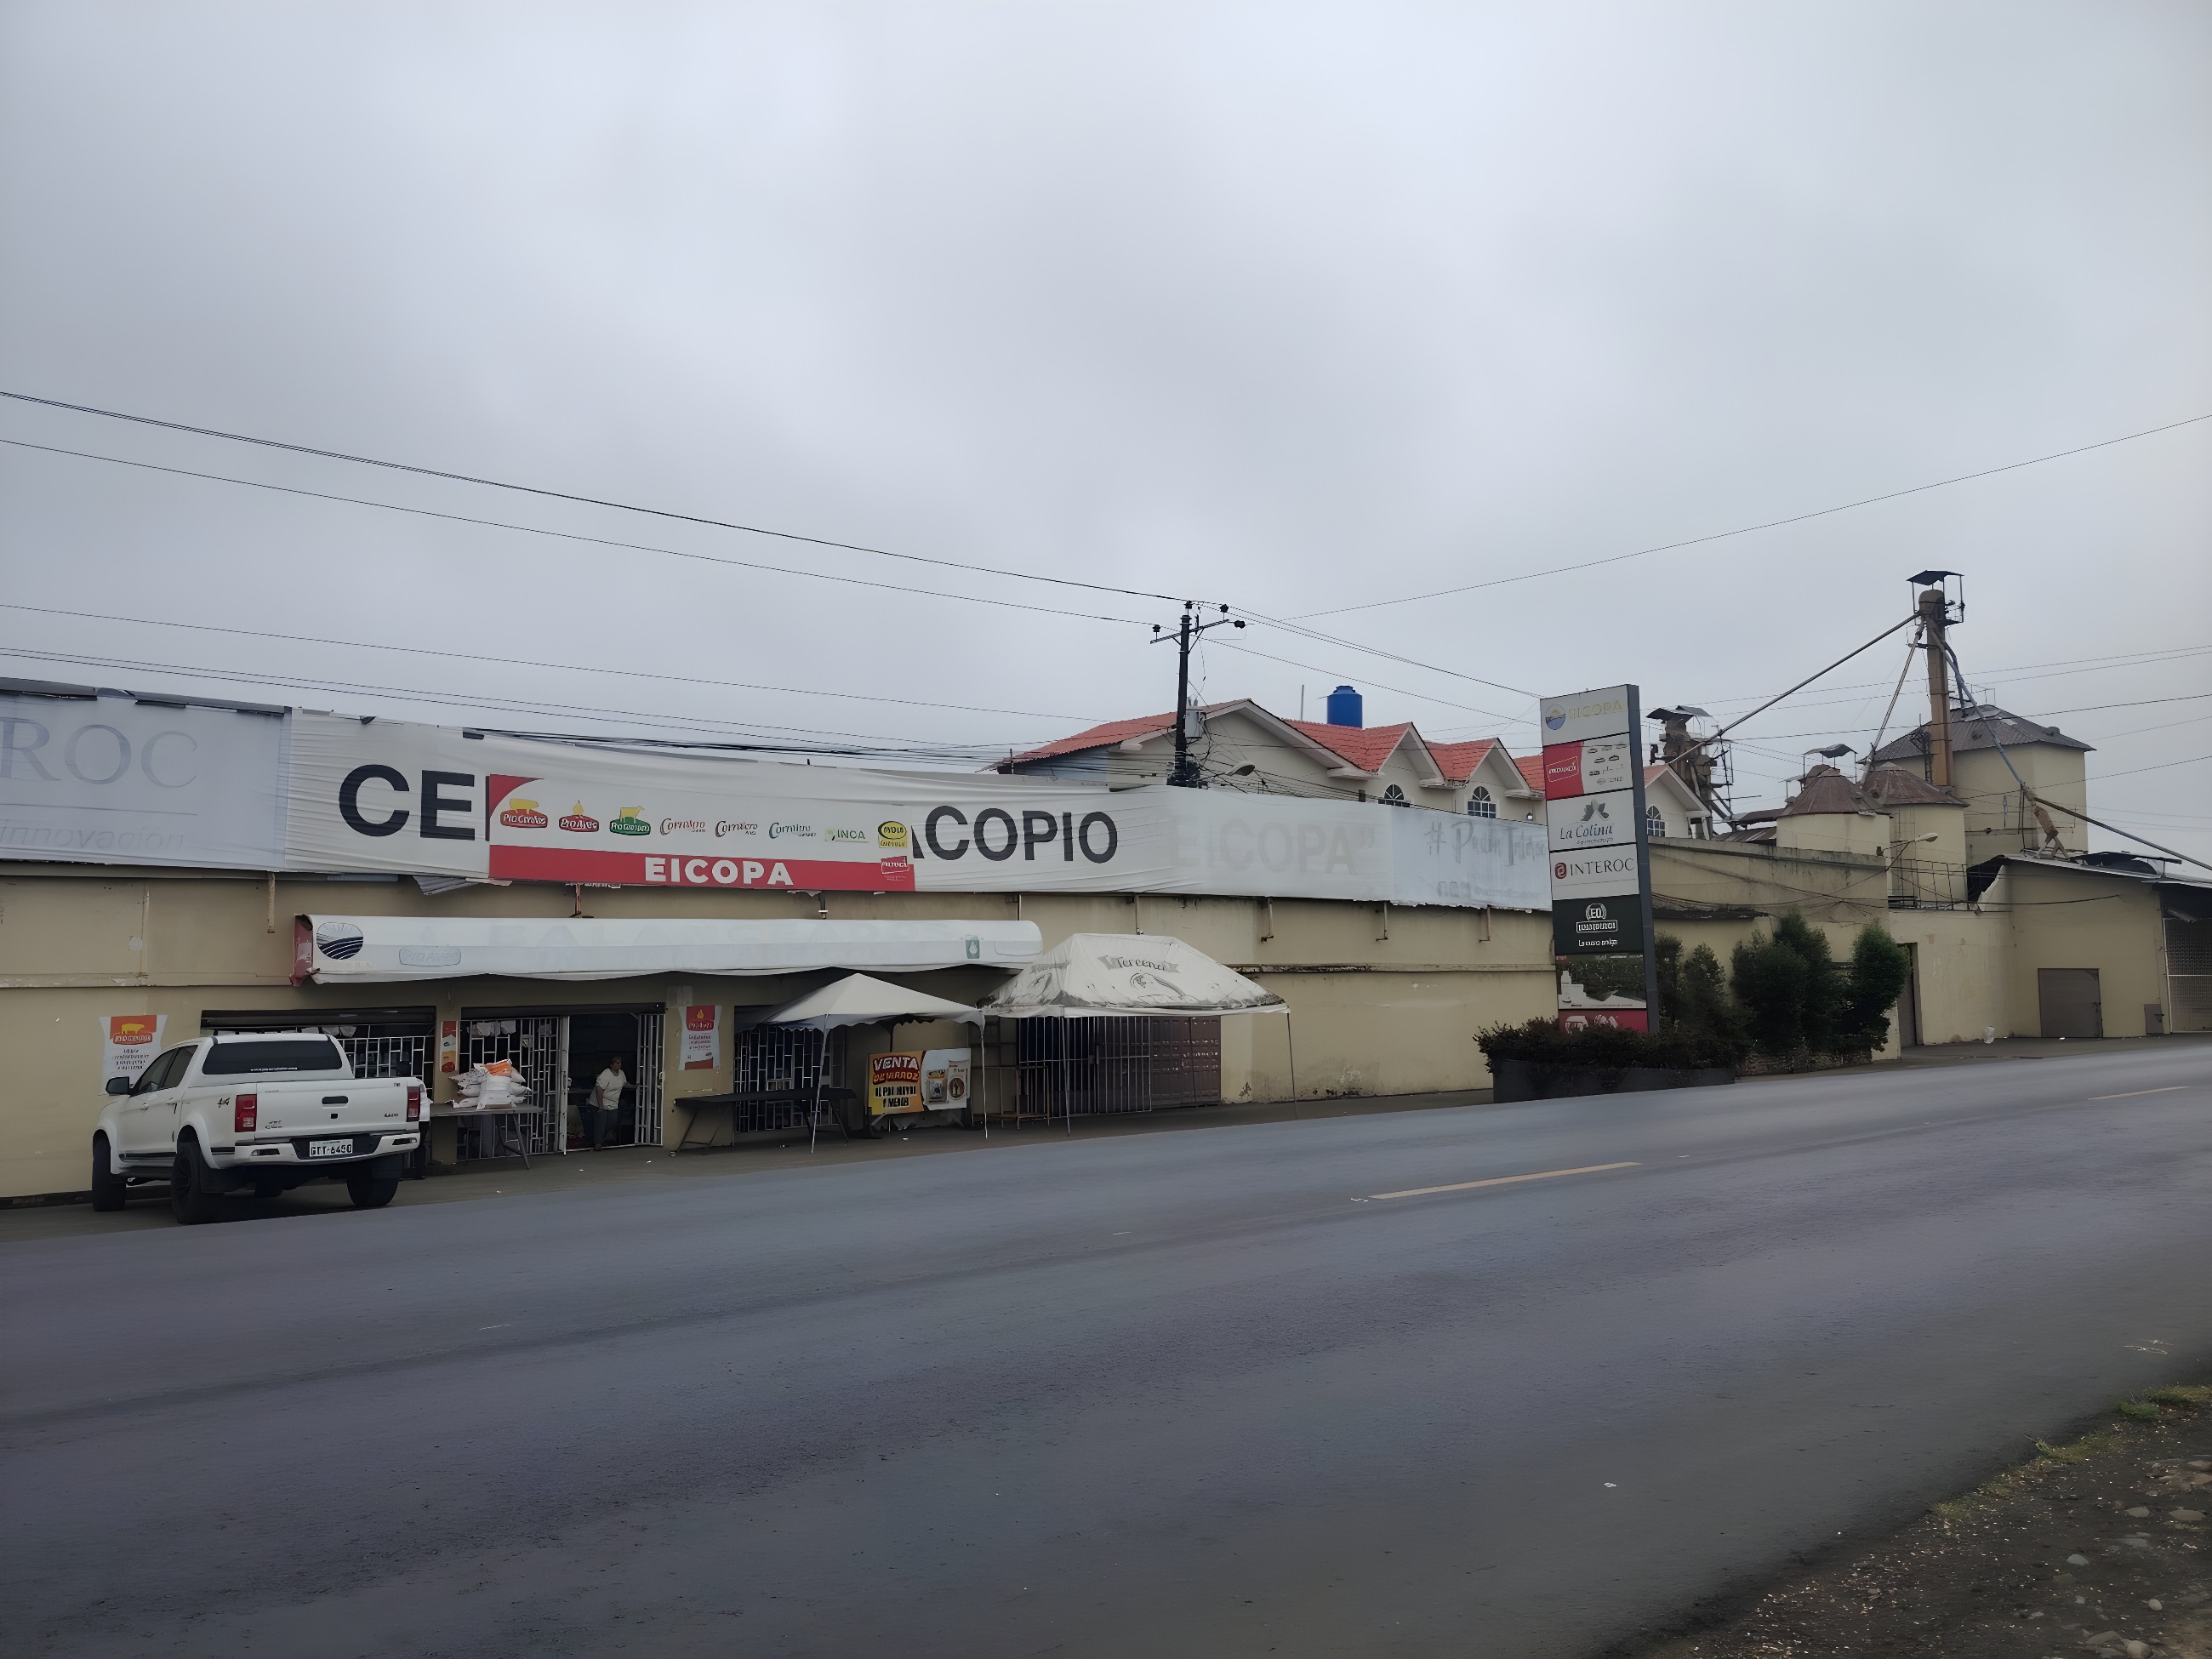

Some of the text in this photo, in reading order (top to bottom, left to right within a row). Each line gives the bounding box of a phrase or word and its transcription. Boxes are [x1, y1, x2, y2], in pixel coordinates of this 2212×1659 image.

[339, 764, 491, 842] CE
[645, 857, 795, 886] EICOPA
[1570, 858, 1635, 875] INTEROC
[874, 1056, 918, 1071] VENTA
